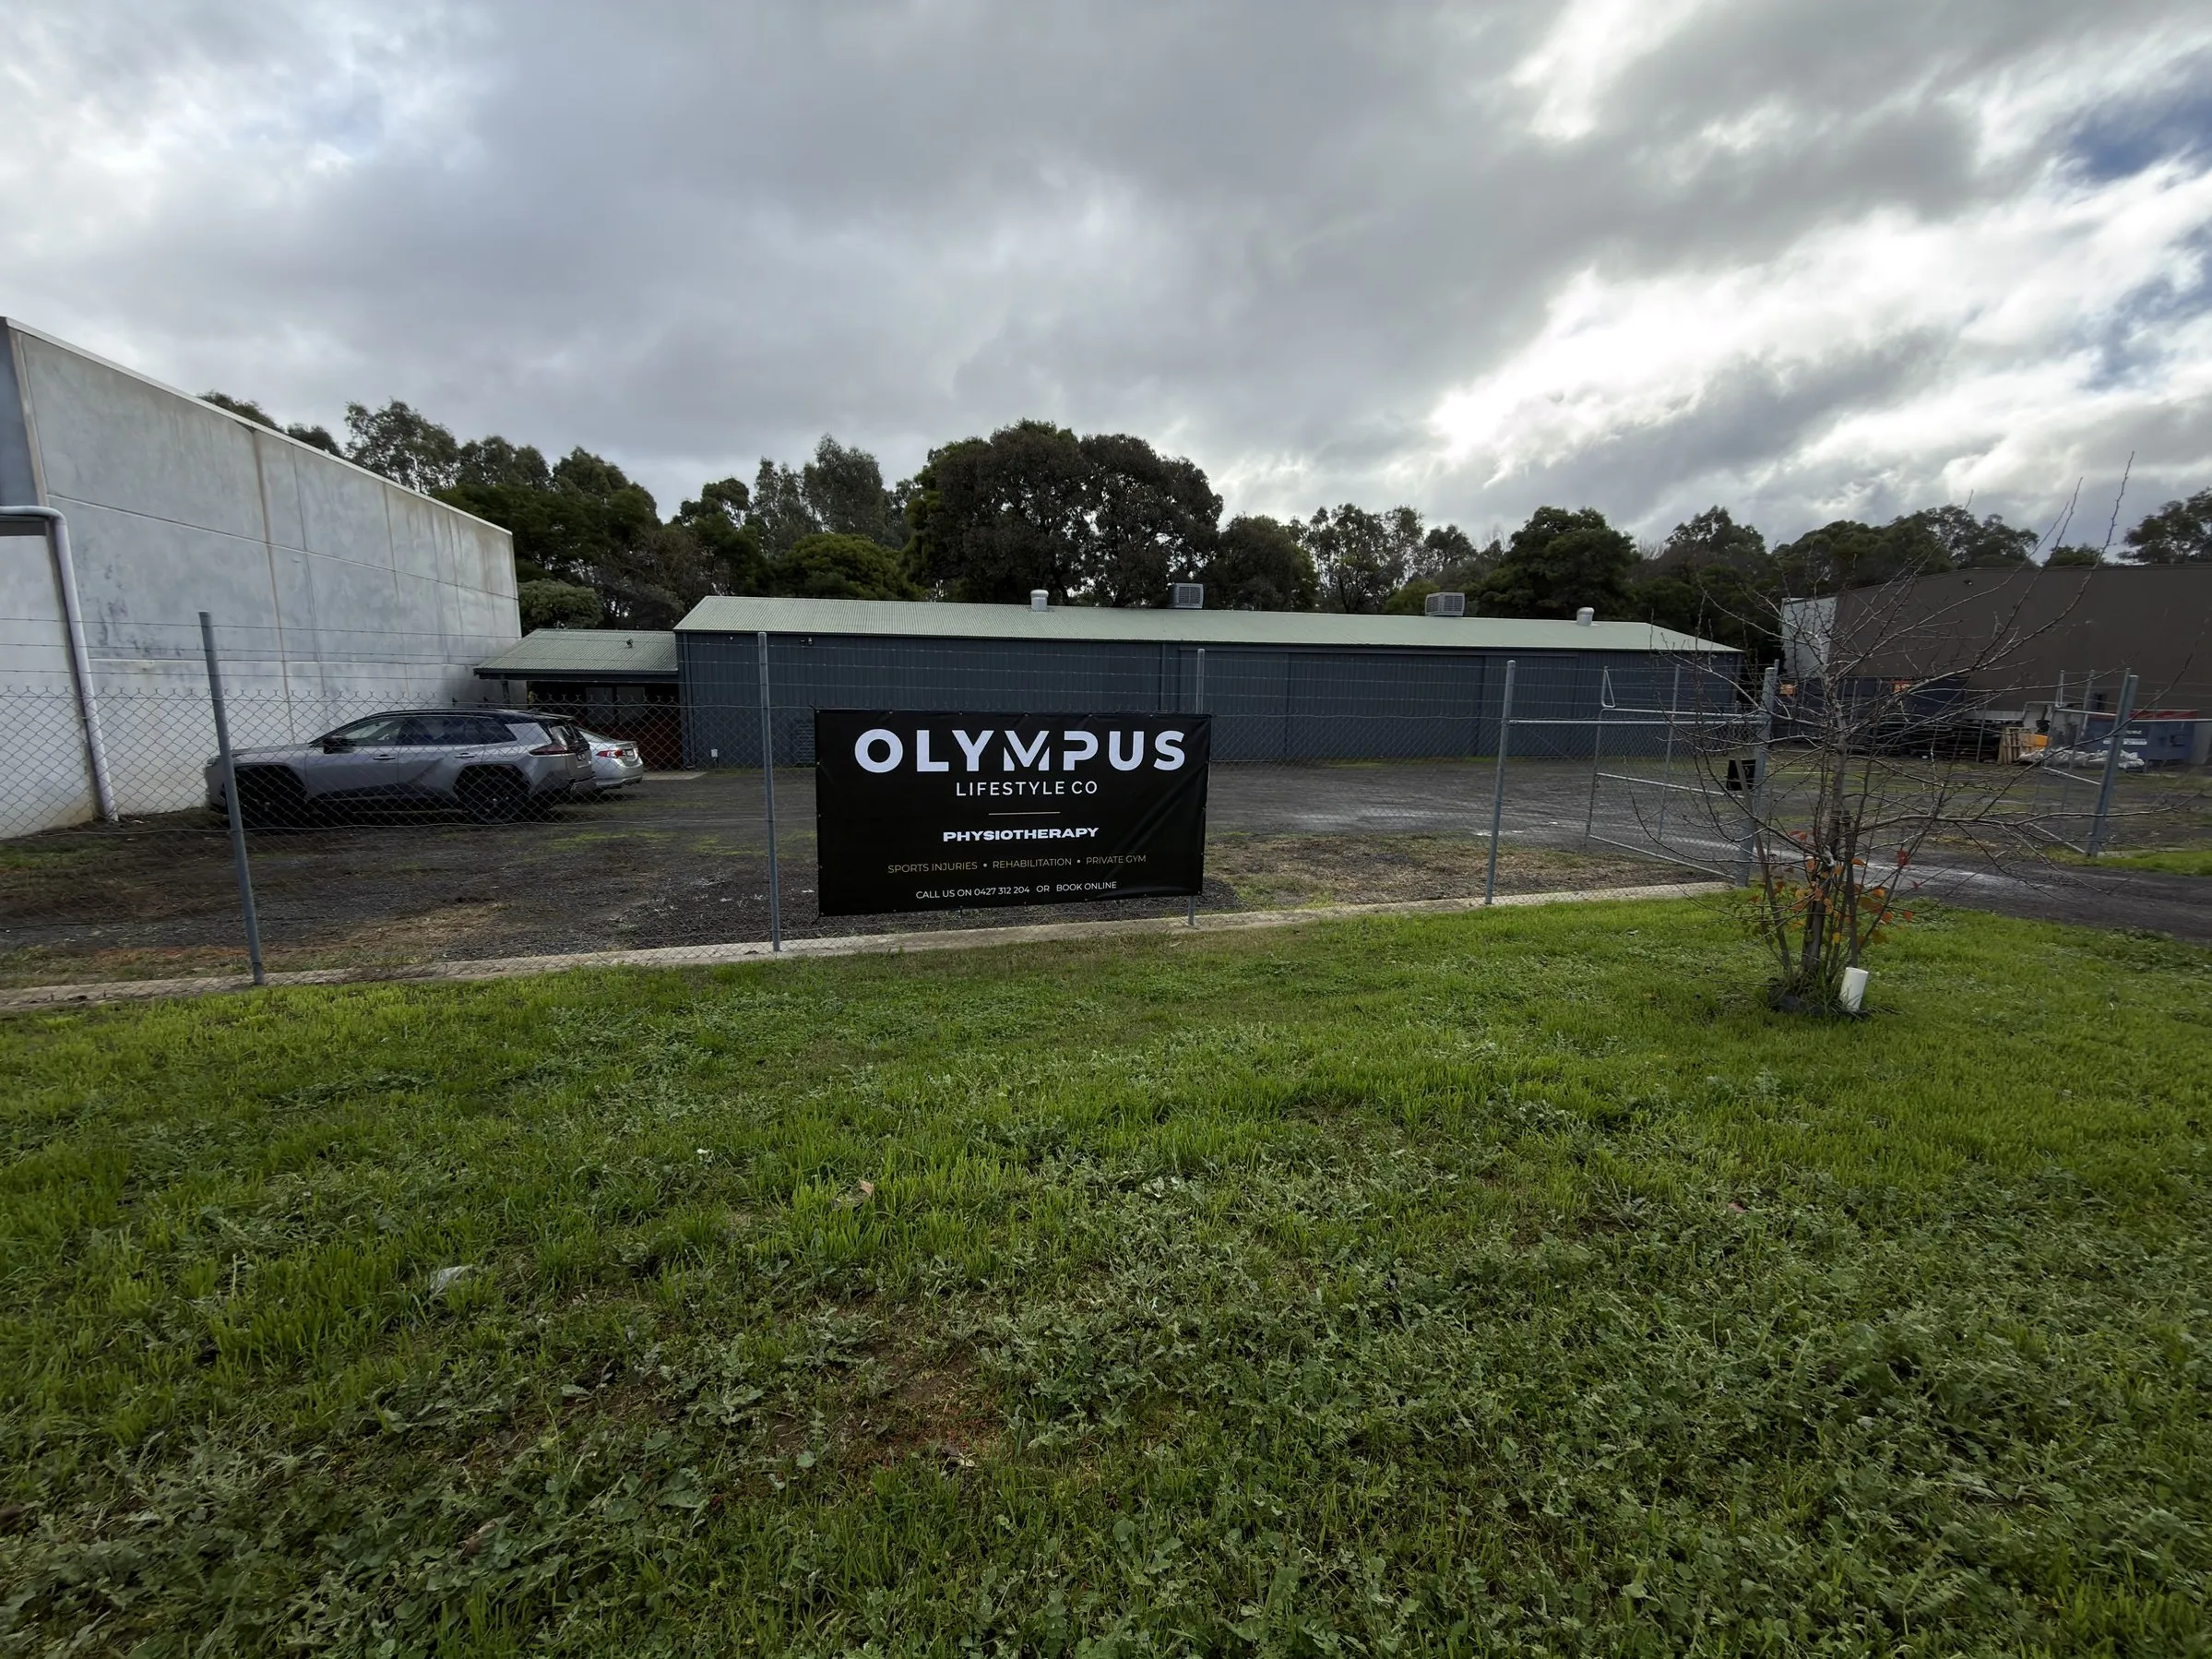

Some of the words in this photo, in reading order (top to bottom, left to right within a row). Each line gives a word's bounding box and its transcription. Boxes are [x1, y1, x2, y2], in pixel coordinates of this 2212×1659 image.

[854, 728, 1185, 773] OLYMPUS
[956, 782, 1065, 796] LIFESTYLE
[1071, 781, 1098, 794] CO
[943, 827, 1100, 842] PHYSIOTHERAPY
[887, 864, 930, 874] SPORTS
[932, 861, 978, 872] INJURIES
[993, 858, 1072, 869] REHABILITATION
[1086, 856, 1124, 865] PRIVATE
[1125, 854, 1147, 864] GYM
[915, 890, 941, 900] CALL
[942, 889, 956, 898] US
[957, 889, 972, 897] ON
[973, 887, 996, 896] 0427
[997, 887, 1012, 895] 312
[1013, 886, 1030, 894] 204
[1036, 884, 1051, 893] OR
[1056, 883, 1084, 892] BOOK
[1084, 881, 1117, 890] ONLINE
